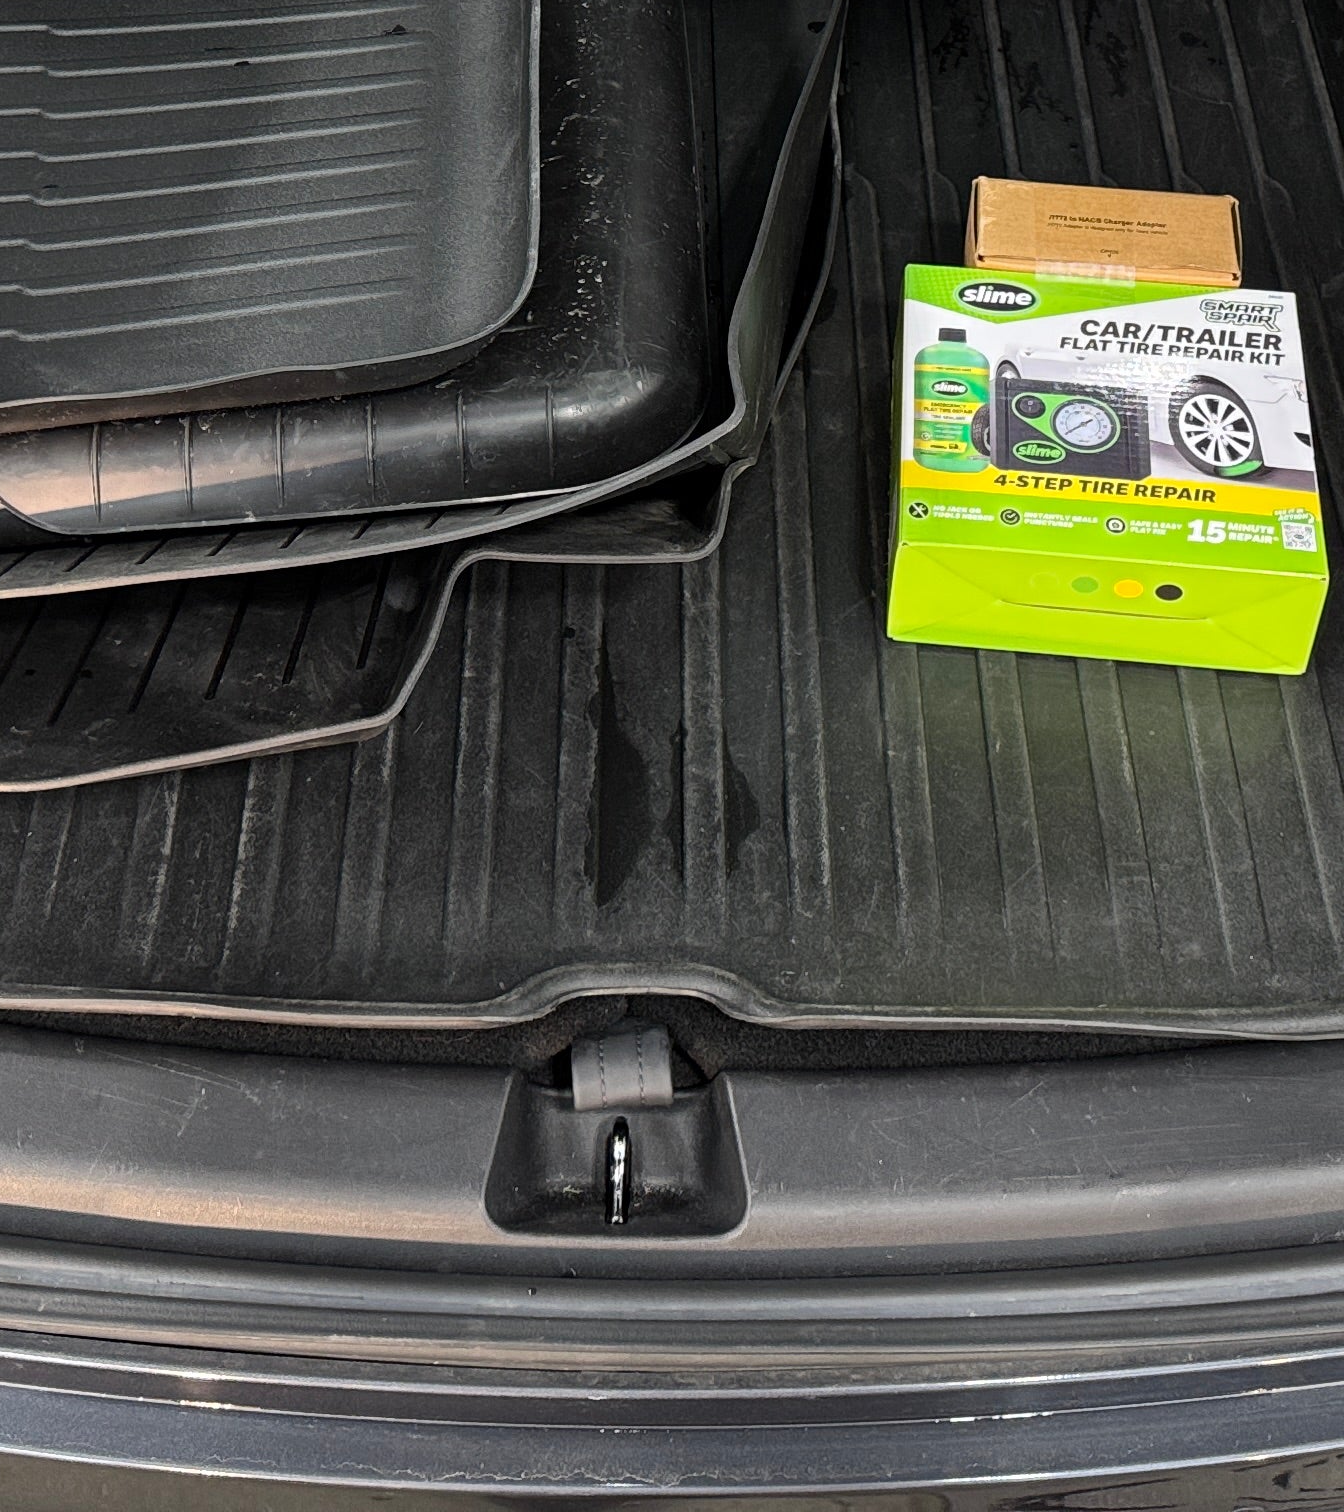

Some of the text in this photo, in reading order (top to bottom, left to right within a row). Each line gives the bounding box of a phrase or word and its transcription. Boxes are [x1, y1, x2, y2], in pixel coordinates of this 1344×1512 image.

[962, 285, 1033, 306] slime
[1202, 299, 1278, 316] SMART
[1208, 311, 1280, 332] SPAIR
[1080, 319, 1282, 352] CAR/TRAILER
[1059, 336, 1286, 367] FLAT TIRE REPAIR KIT
[933, 381, 966, 394] slime
[1017, 444, 1062, 459] slime
[994, 474, 1217, 504] 4-STEP TIRE REPAIR
[1186, 518, 1227, 544] 15
[1228, 521, 1275, 535] MINUTE
